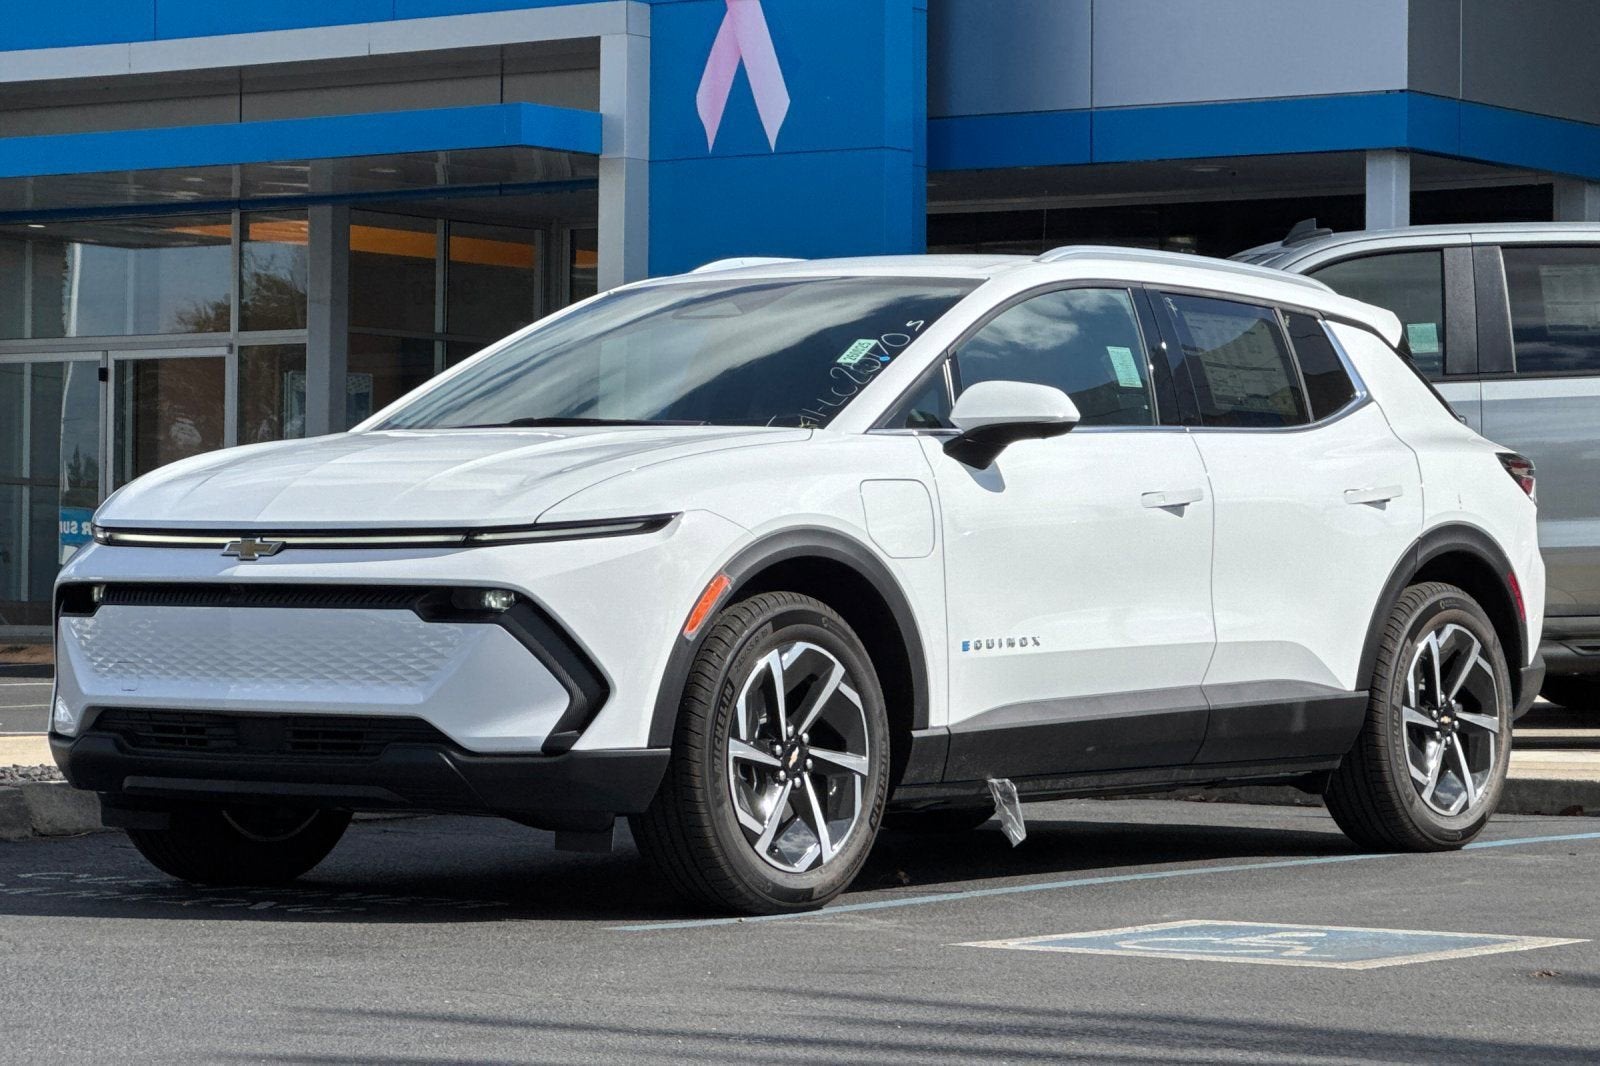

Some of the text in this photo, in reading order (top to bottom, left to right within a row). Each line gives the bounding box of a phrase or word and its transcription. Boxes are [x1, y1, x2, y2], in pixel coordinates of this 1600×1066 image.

[961, 636, 1041, 652] EQUINOX
[712, 683, 735, 774] MICHELIN
[870, 740, 887, 826] MICHELIN
